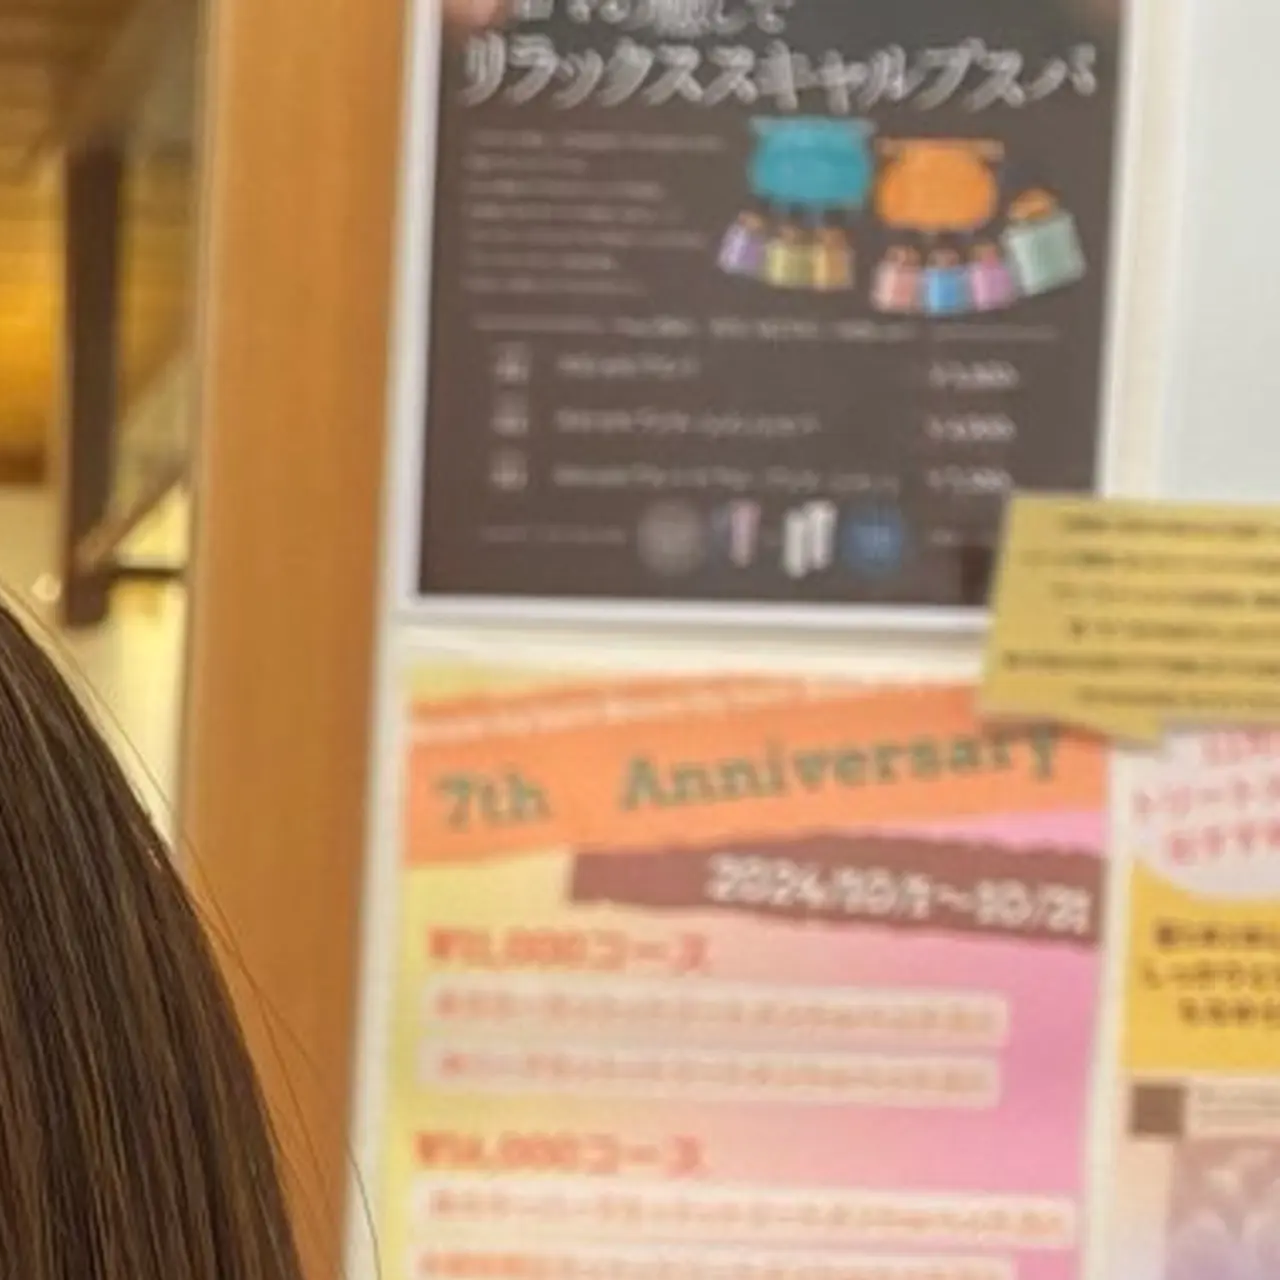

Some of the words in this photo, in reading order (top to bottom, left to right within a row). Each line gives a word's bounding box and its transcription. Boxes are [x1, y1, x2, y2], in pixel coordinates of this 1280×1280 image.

[462, 32, 1096, 112] リラックススキャルプスパ
[437, 763, 551, 831] 7th
[620, 718, 1061, 810] Anniversary
